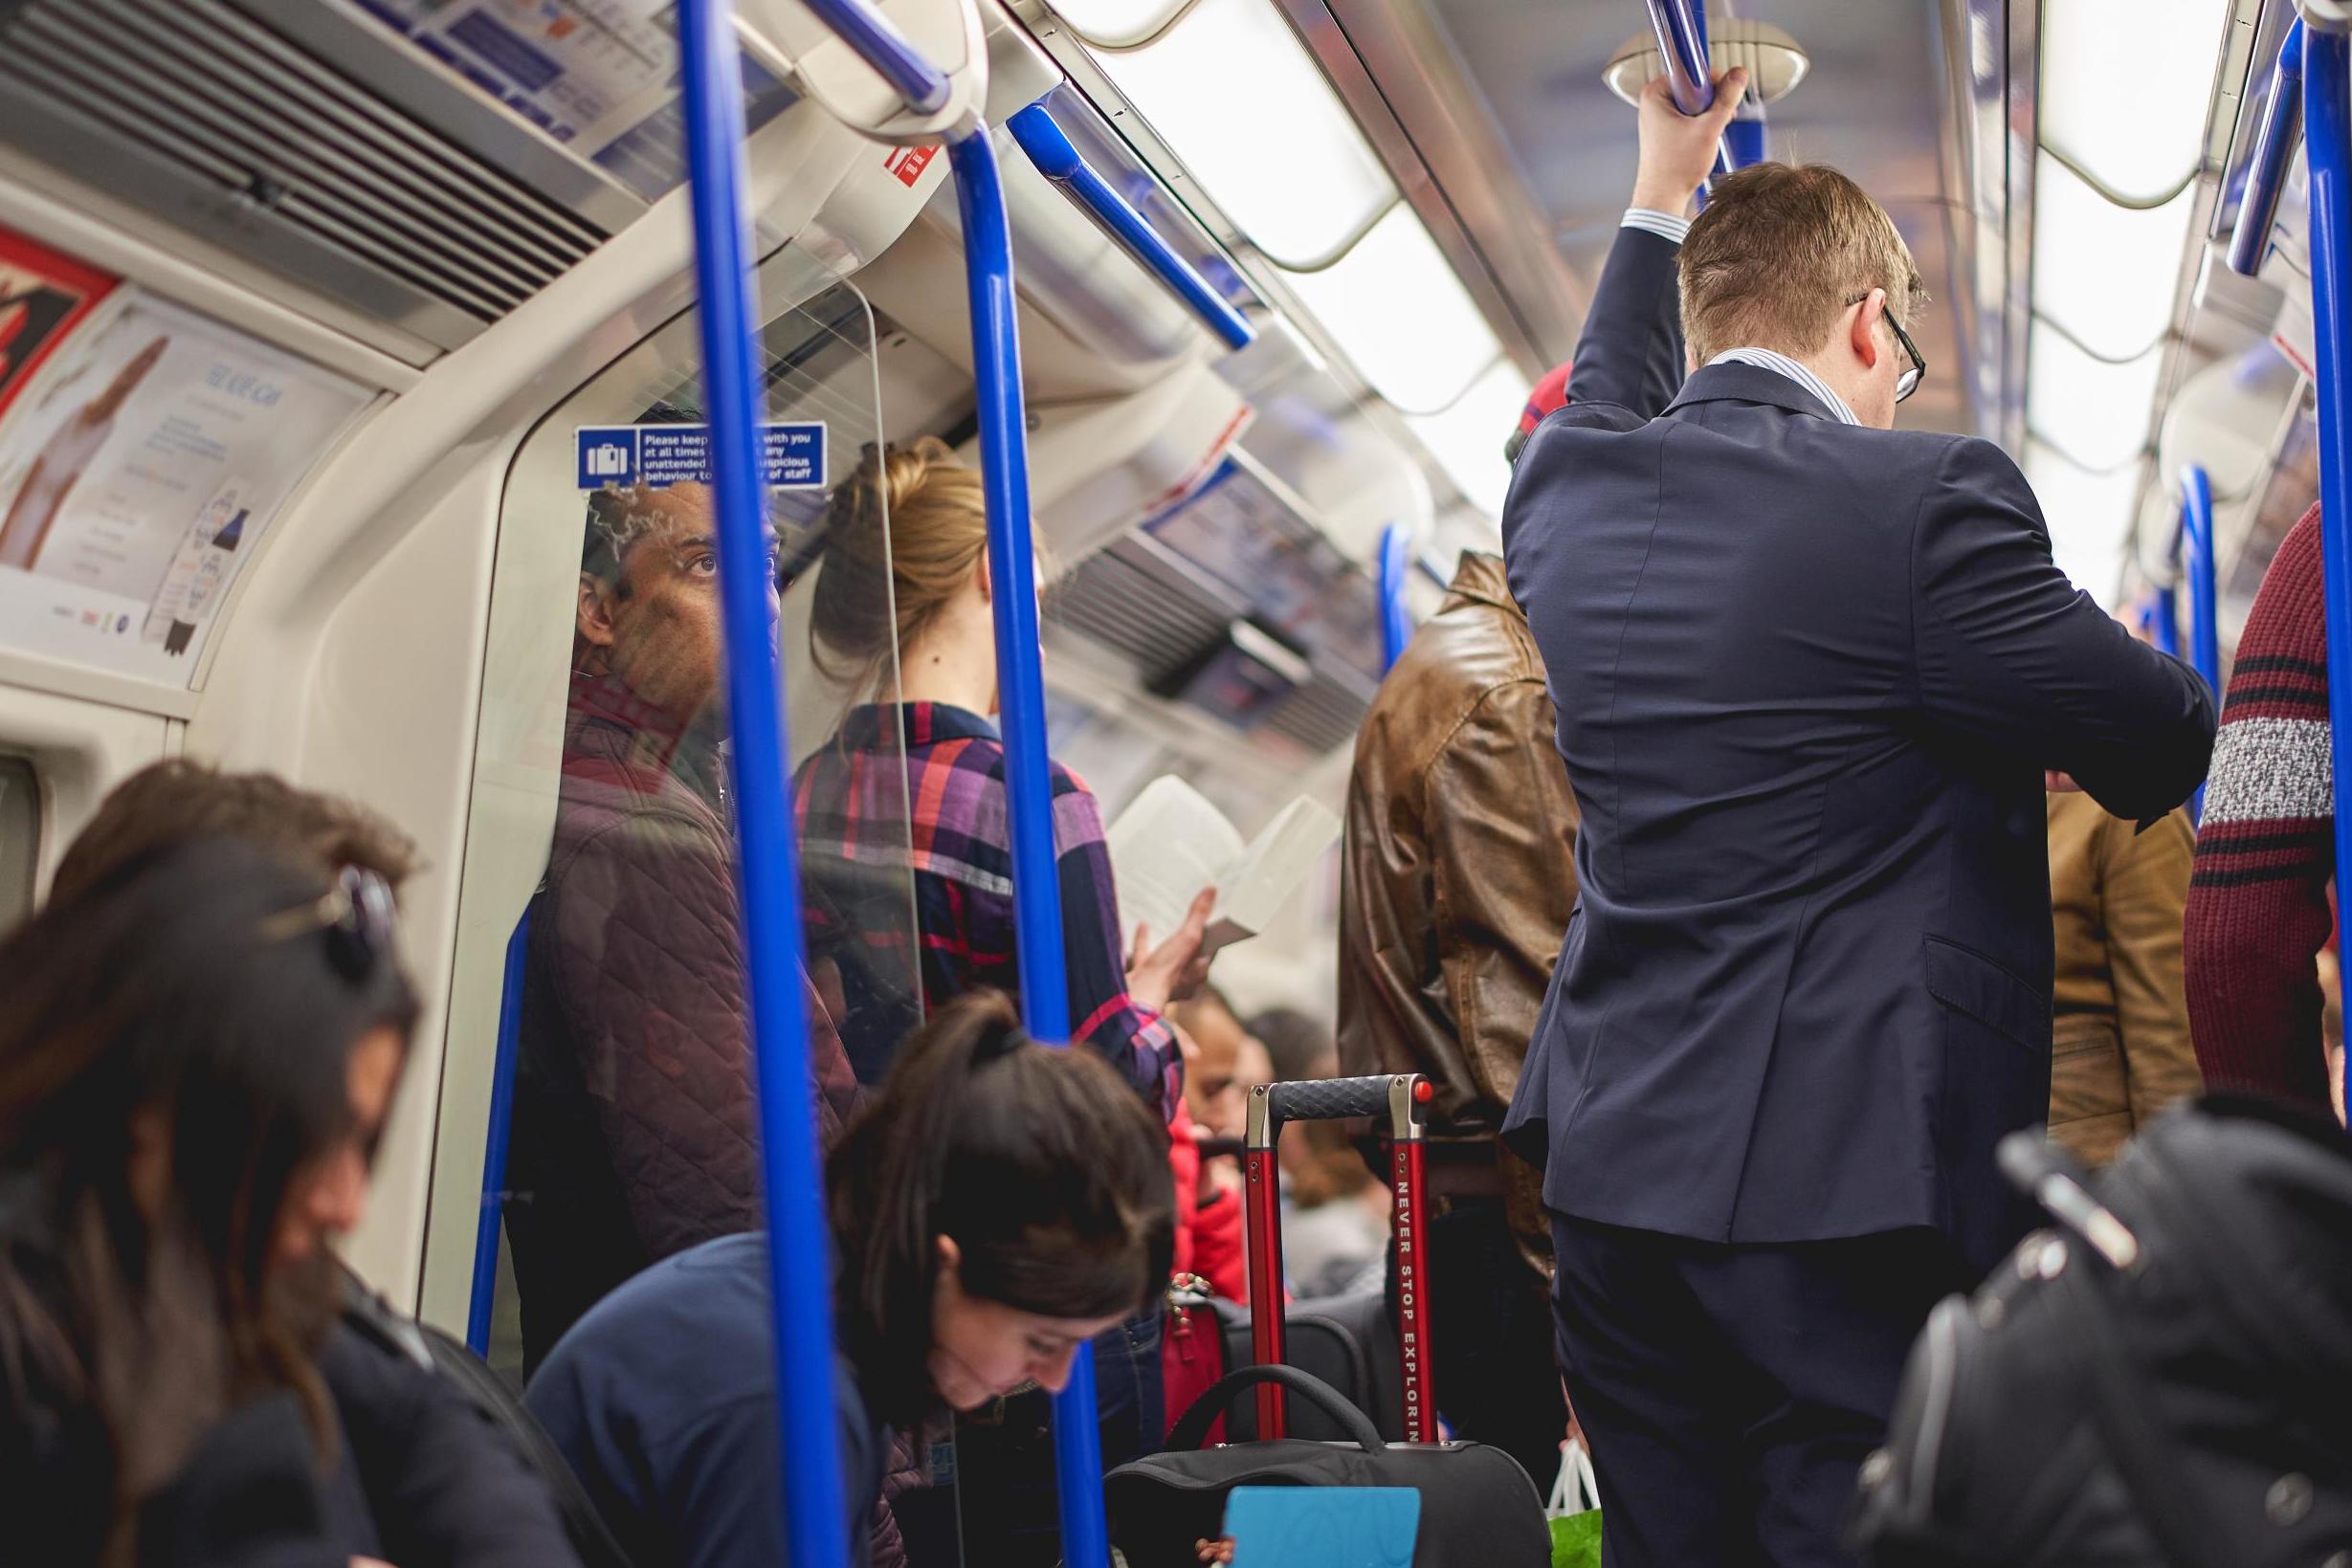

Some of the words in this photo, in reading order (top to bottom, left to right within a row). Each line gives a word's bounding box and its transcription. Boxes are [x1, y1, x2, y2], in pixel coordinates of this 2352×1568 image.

[645, 434, 679, 445] Please
[682, 434, 708, 447] keep
[764, 432, 788, 444] with
[790, 433, 811, 446] you
[645, 448, 656, 457] at
[659, 447, 672, 457] all
[675, 447, 705, 457] times
[766, 447, 785, 457] any
[645, 458, 706, 469] unattended
[759, 457, 810, 469] uspicious
[645, 471, 697, 482] behaviour
[699, 472, 712, 480] to
[769, 469, 783, 479] of
[785, 468, 811, 479] staff
[1398, 1182, 1411, 1253] NEVER
[1402, 1265, 1413, 1320] STOP
[1405, 1333, 1418, 1443] EXPLORIN
